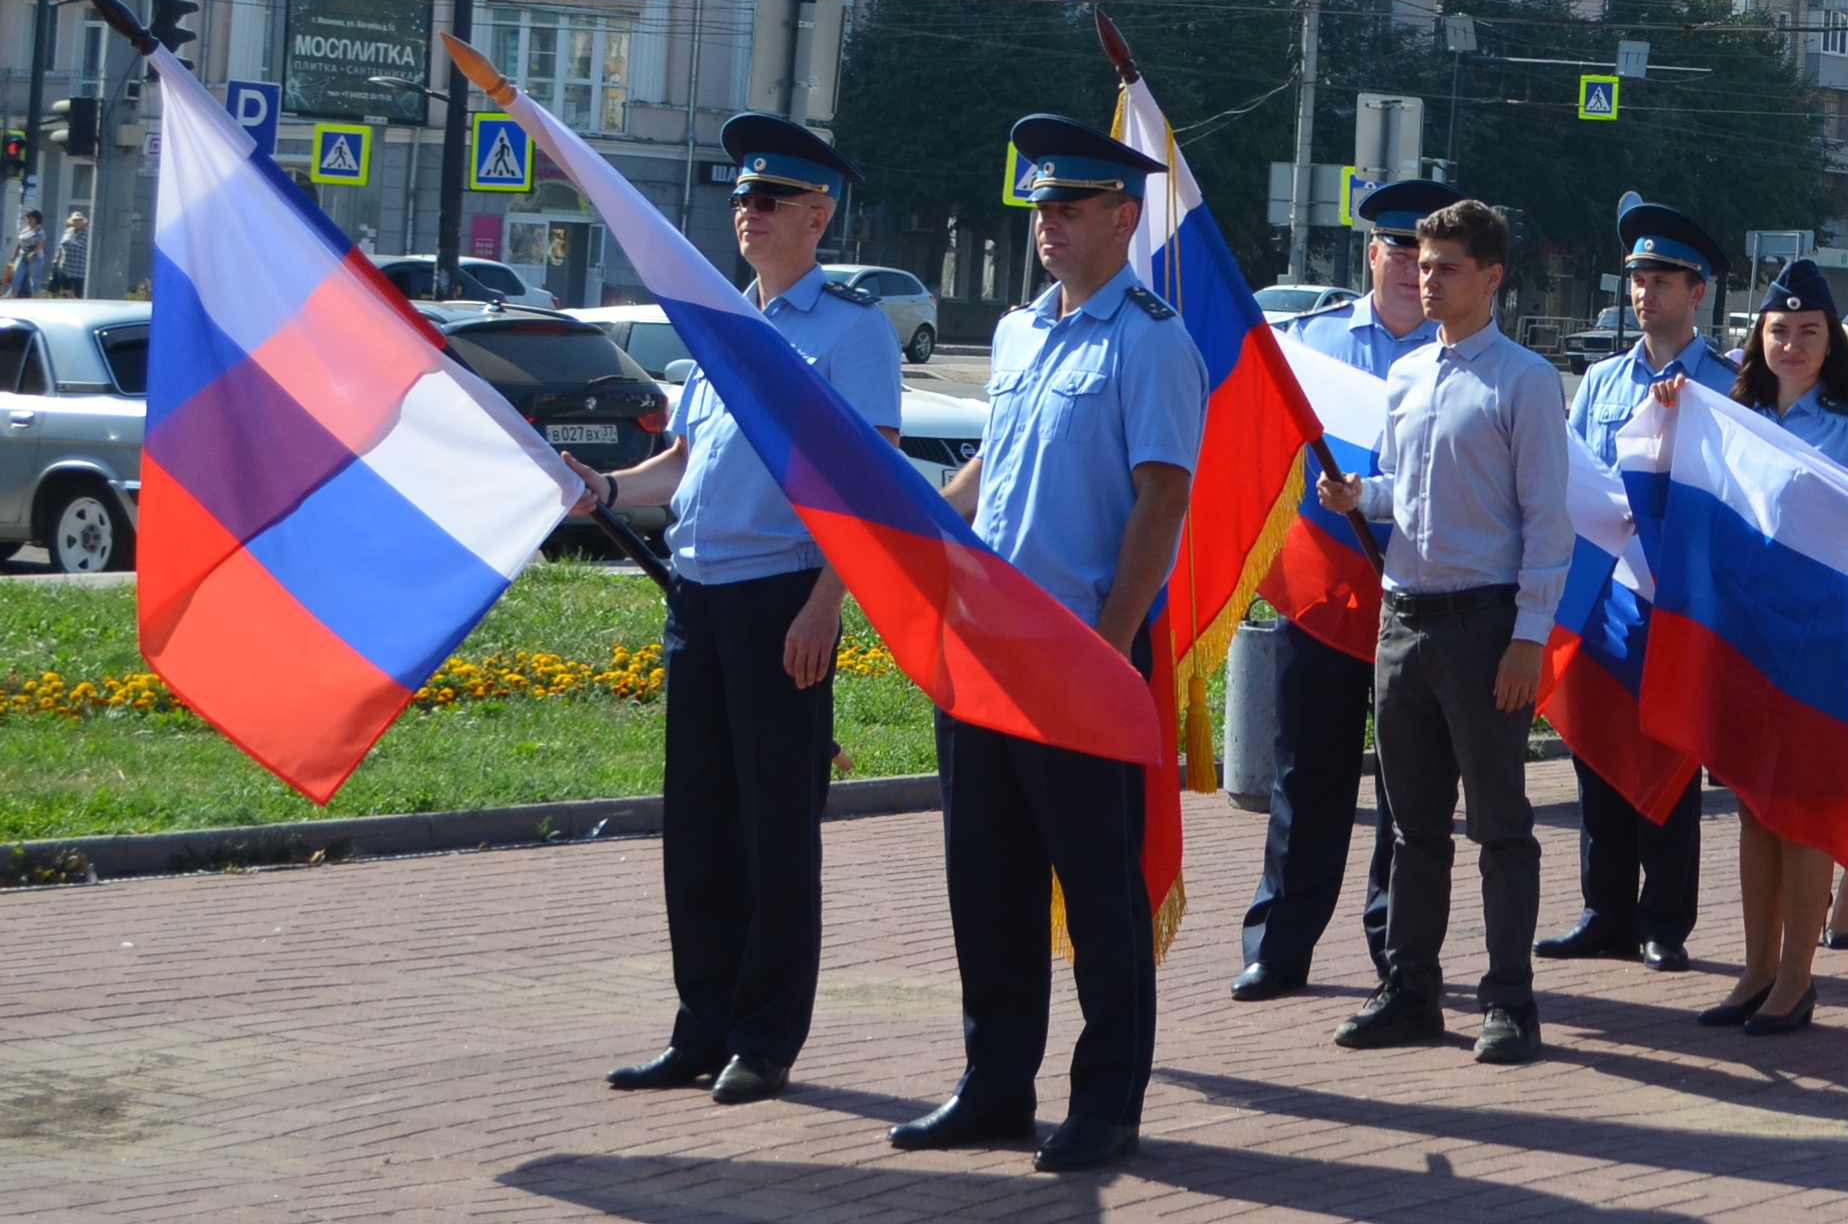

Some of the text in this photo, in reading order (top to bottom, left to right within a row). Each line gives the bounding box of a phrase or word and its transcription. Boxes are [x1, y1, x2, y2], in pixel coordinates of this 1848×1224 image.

[295, 34, 416, 67] МОСПЛИТКА
[293, 61, 413, 79] ПЛИТКА САНТЕХНИКА
